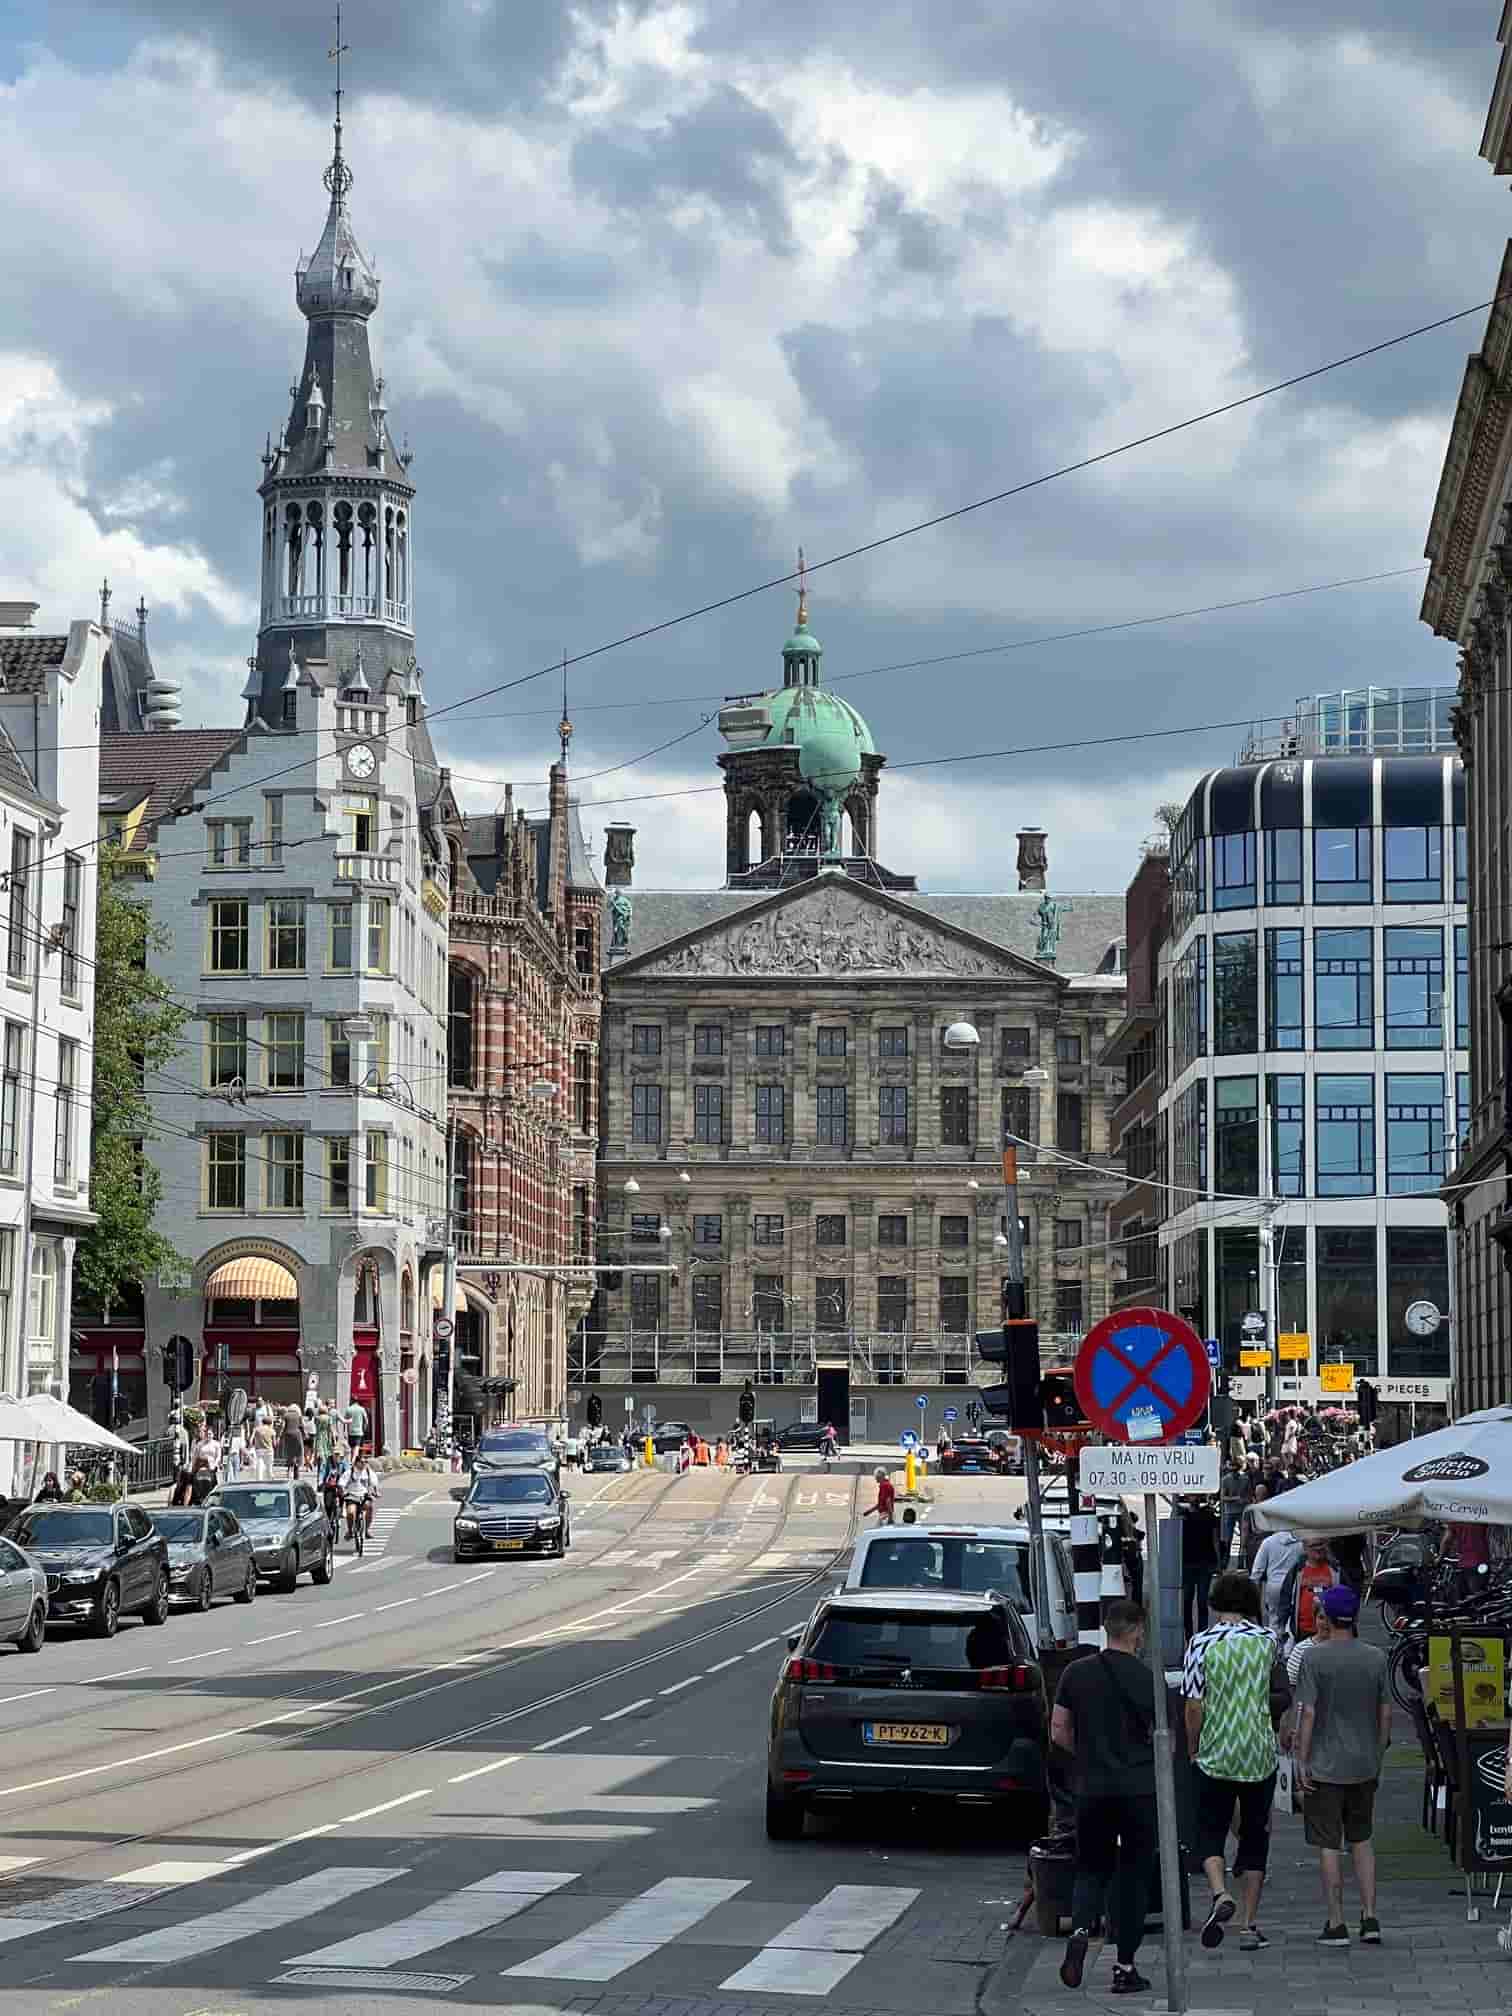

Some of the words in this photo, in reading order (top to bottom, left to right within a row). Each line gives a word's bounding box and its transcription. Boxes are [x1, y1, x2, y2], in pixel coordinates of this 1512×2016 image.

[1387, 1384, 1430, 1396] PIECES
[1111, 1451, 1133, 1465] MA
[1138, 1451, 1158, 1465] t/m
[1163, 1451, 1194, 1465] VRIJ
[1088, 1471, 1126, 1485] 07.30
[1140, 1471, 1178, 1485] 09.00
[1183, 1474, 1206, 1485] uur
[879, 1726, 943, 1740] PT-962-K
